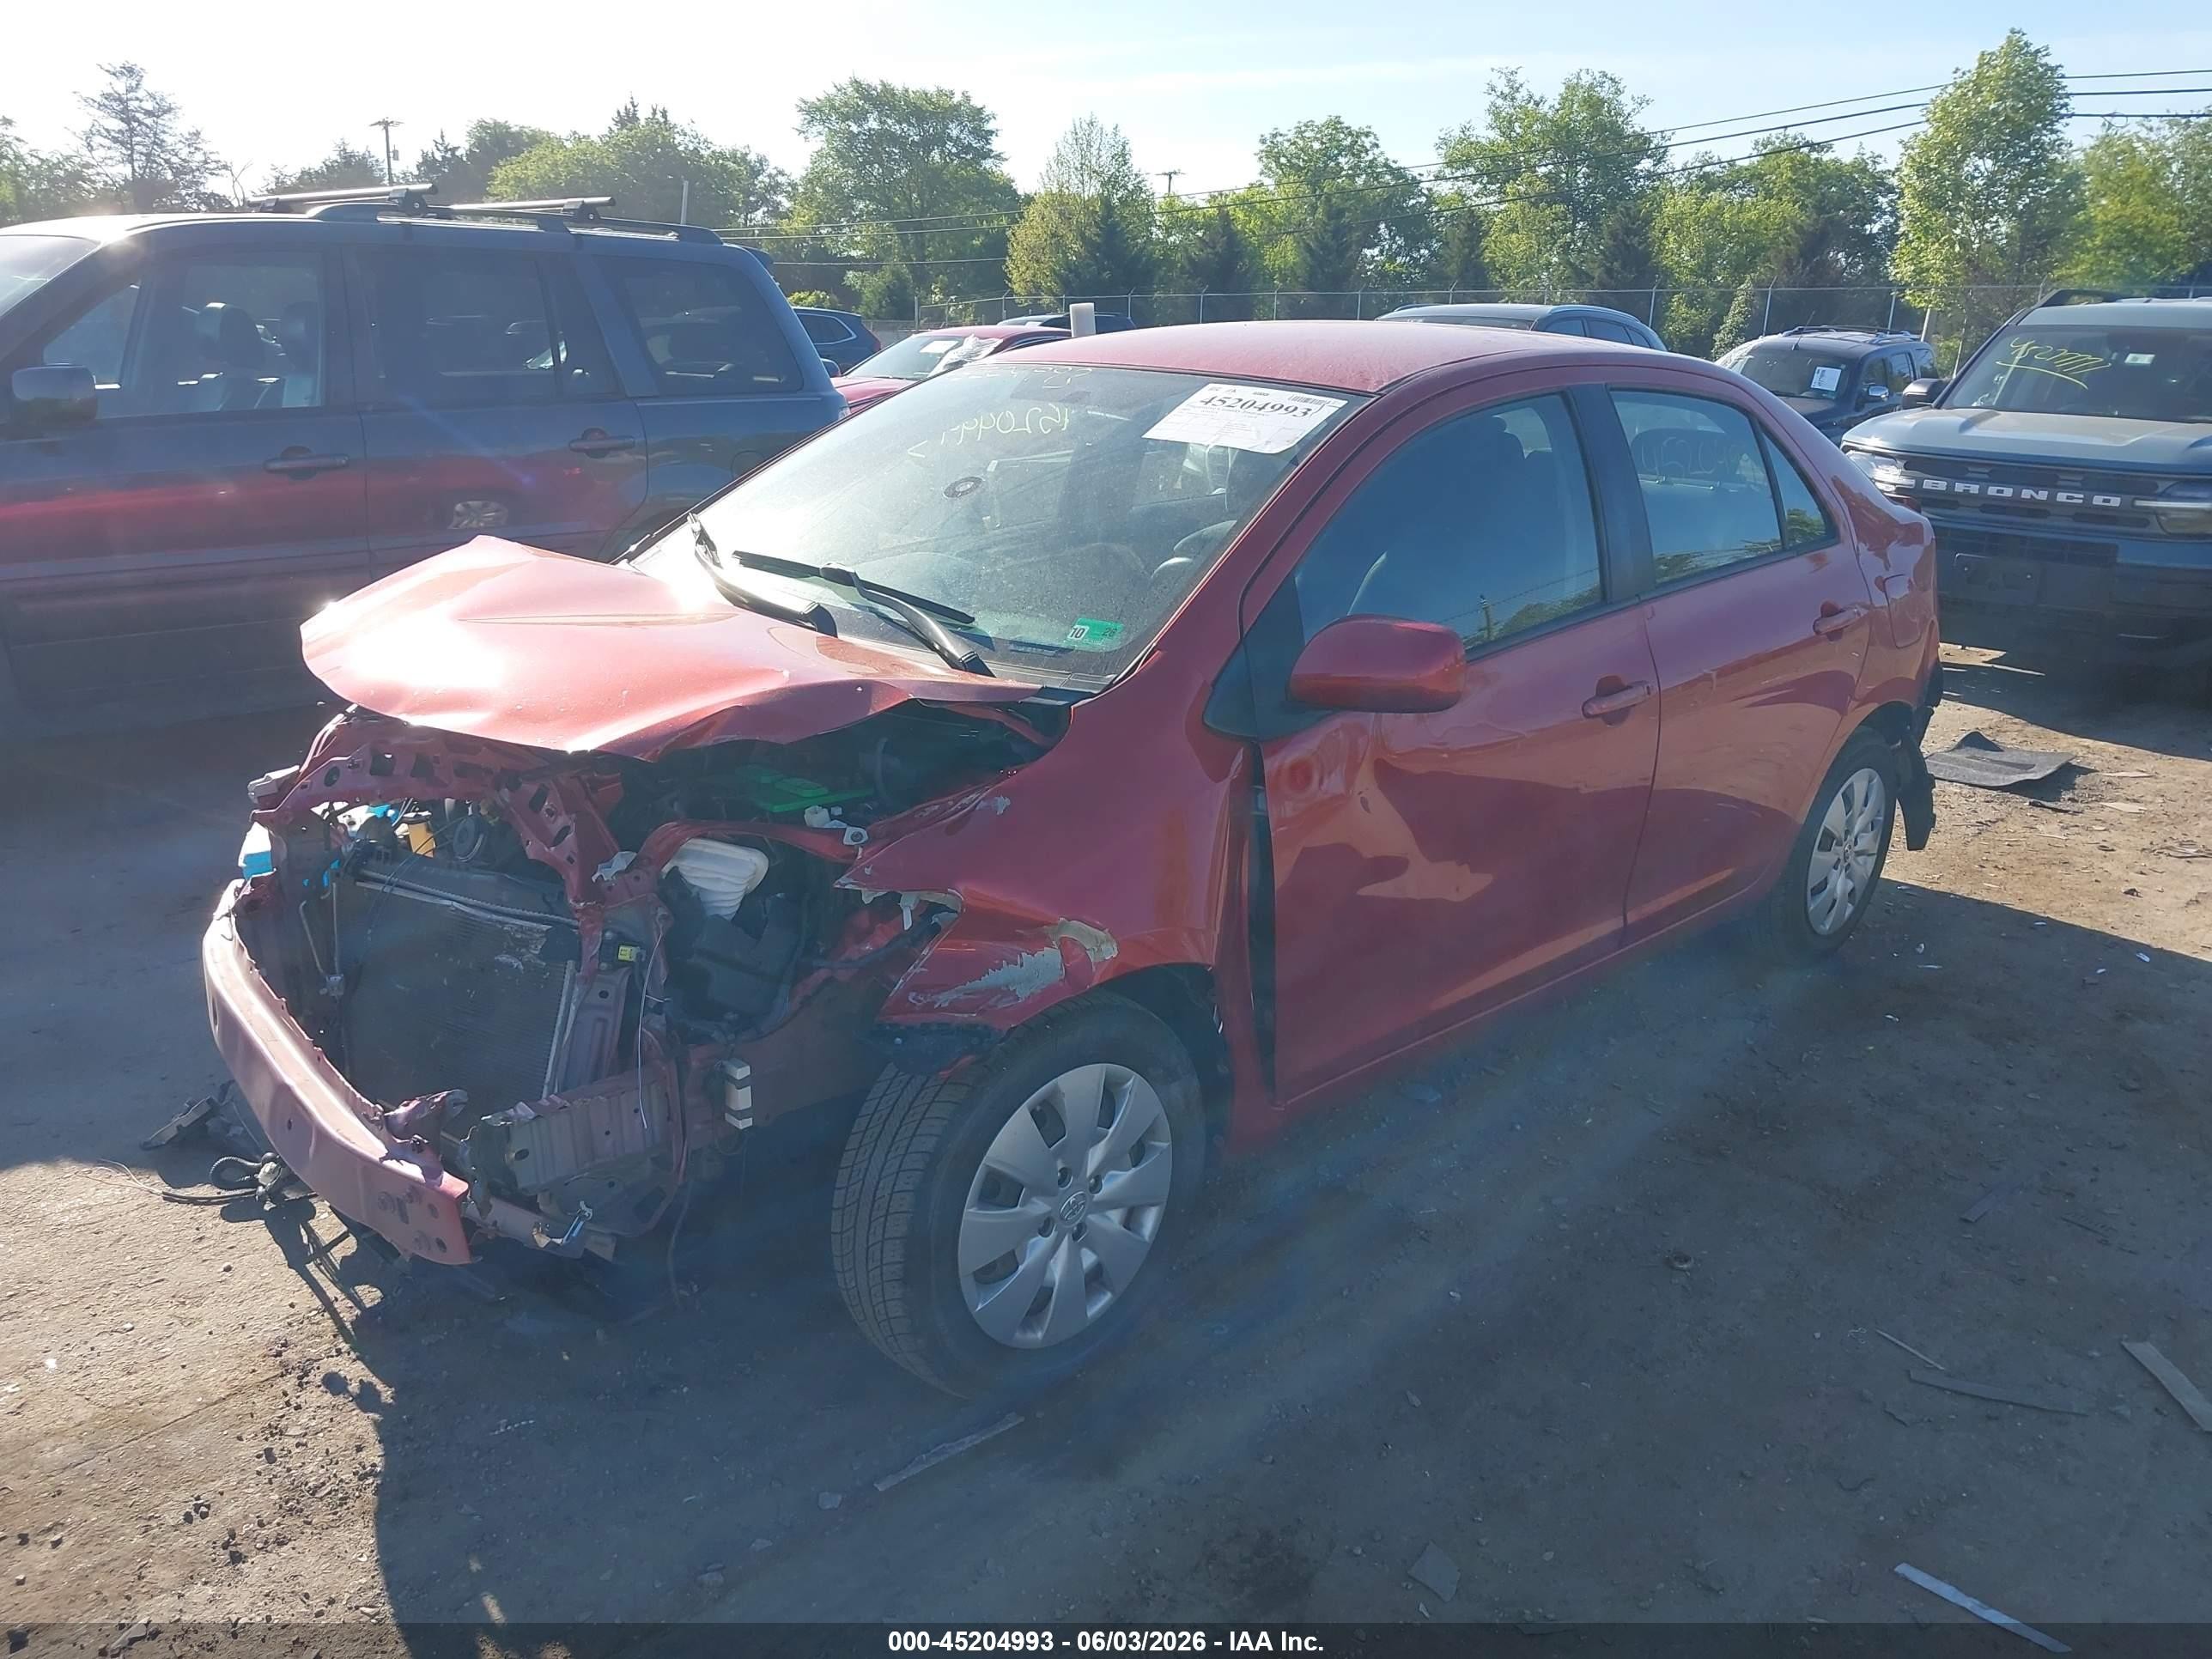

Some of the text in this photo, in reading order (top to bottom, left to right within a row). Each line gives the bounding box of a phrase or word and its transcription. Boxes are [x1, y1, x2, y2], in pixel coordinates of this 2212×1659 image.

[1200, 395, 1312, 418] 45204993
[1922, 479, 2121, 507] BRONCO
[1070, 627, 1086, 639] 10
